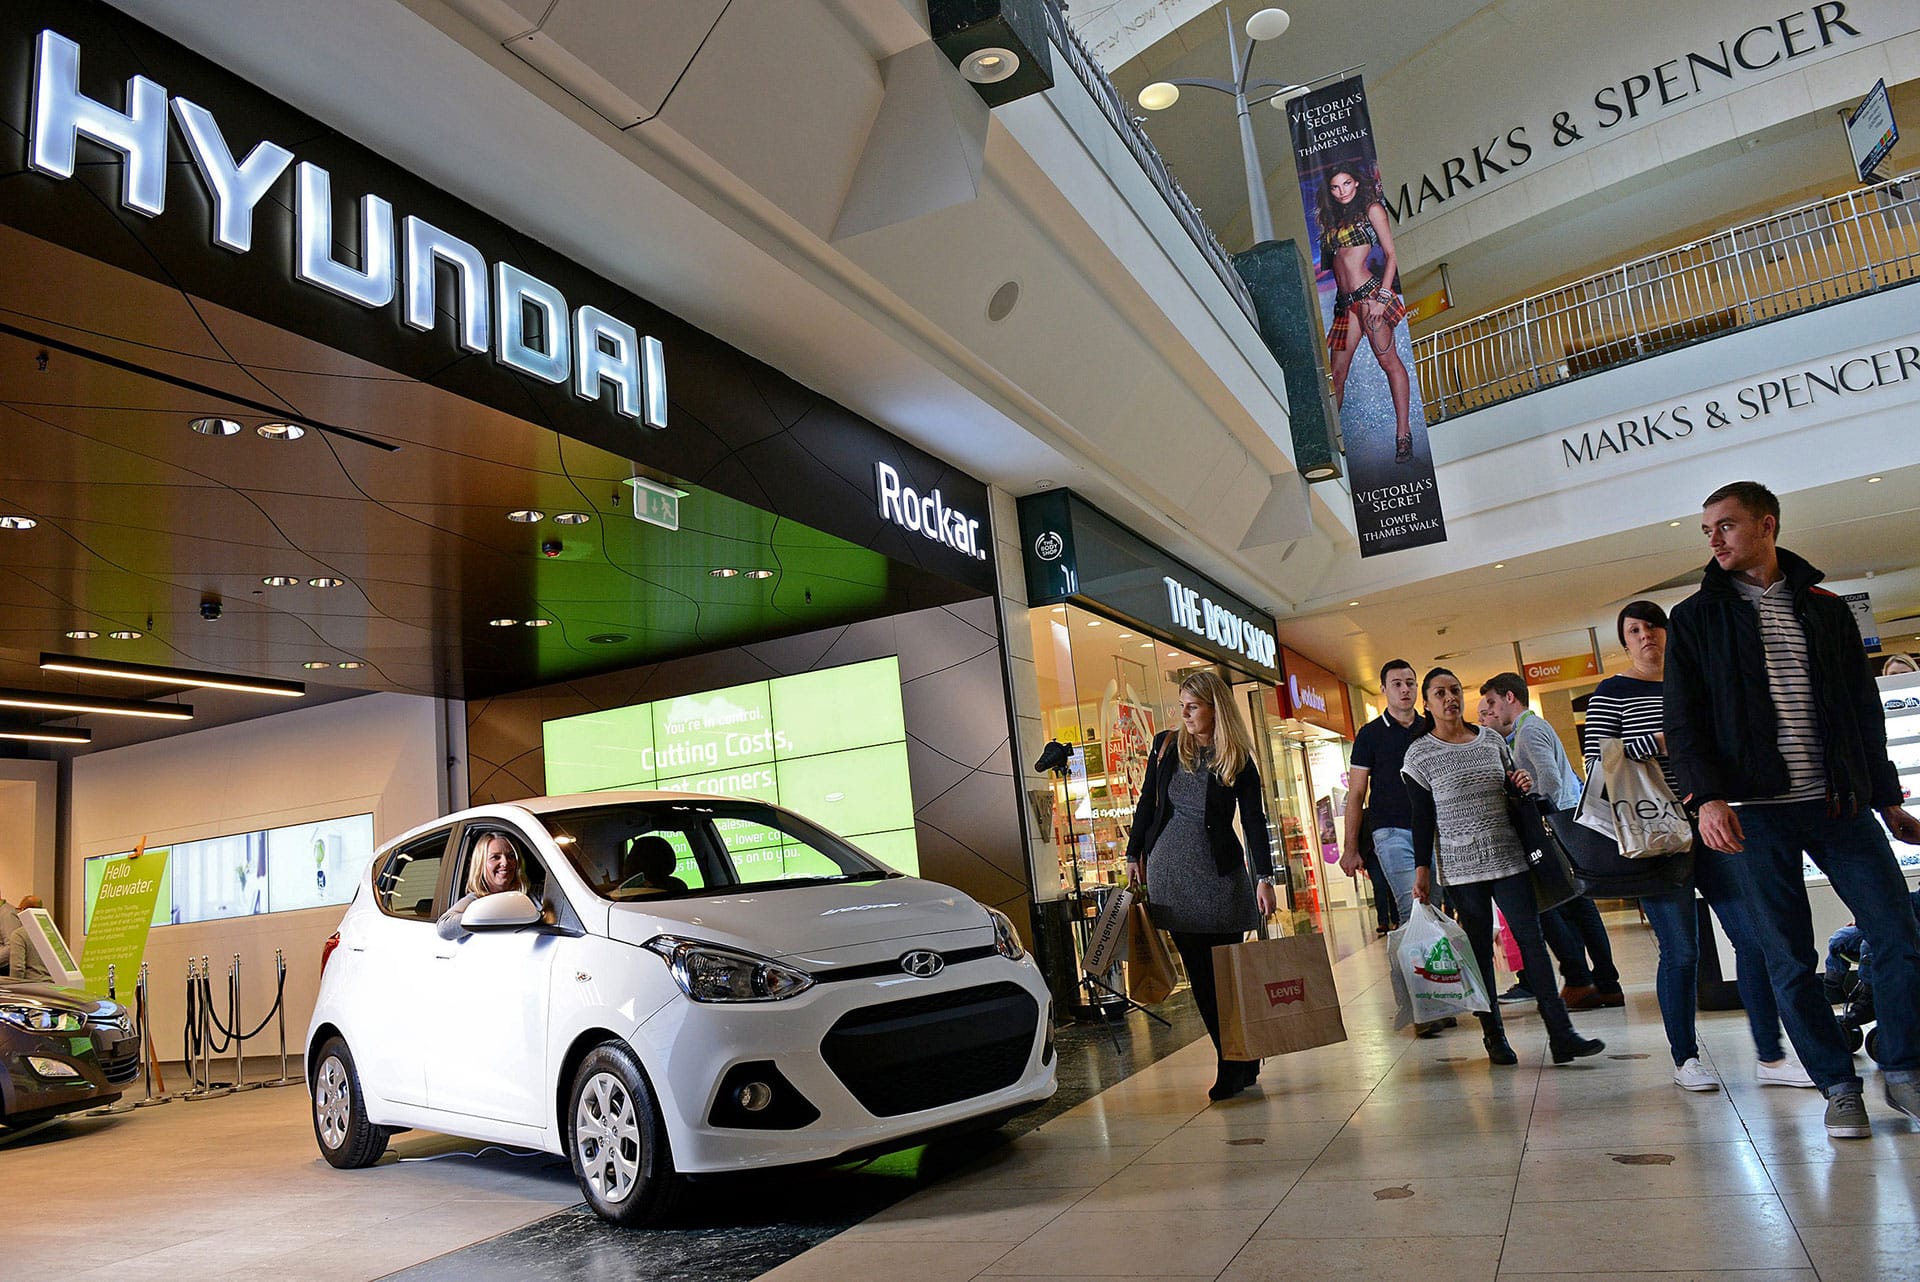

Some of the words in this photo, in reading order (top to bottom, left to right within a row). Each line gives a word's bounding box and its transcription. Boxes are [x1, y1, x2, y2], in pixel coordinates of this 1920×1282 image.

[1291, 92, 1363, 124] VICTORIA'S
[1307, 106, 1352, 130] SECRET
[1384, 126, 1532, 225] MARKS
[1552, 111, 1584, 148] &
[1594, 0, 1861, 128] SPENCER
[1298, 137, 1338, 158] THAMES
[1340, 127, 1368, 142] WALK
[1314, 125, 1348, 143] LOWER
[28, 28, 669, 430] HYUNDAI
[1561, 405, 1694, 468] MARKS
[1705, 401, 1731, 429] &
[1737, 346, 1920, 420] SPENCER
[1356, 478, 1433, 503] VICTORIA'S
[875, 461, 986, 561] Rockar.
[1372, 493, 1422, 513] SECRET
[1363, 525, 1407, 541] THAMES
[1409, 518, 1439, 532] WALK
[1380, 512, 1418, 528] LOWER
[1040, 543, 1058, 552] BODY
[1042, 548, 1058, 557] SHOP
[1163, 576, 1205, 635] THE
[1202, 598, 1244, 654] BODY
[1243, 621, 1276, 669] SHOP
[1528, 665, 1561, 678] Glow
[664, 718, 700, 735] You're
[641, 740, 718, 771] Cutting
[725, 727, 793, 757] Costs,
[696, 769, 776, 794] corners.
[1612, 798, 1688, 822] next
[735, 831, 764, 845] lower
[746, 852, 760, 864] on
[763, 849, 773, 862] to
[104, 863, 131, 881] Hello
[100, 878, 153, 900] Bluewater.
[1091, 893, 1125, 966] www.lush.com
